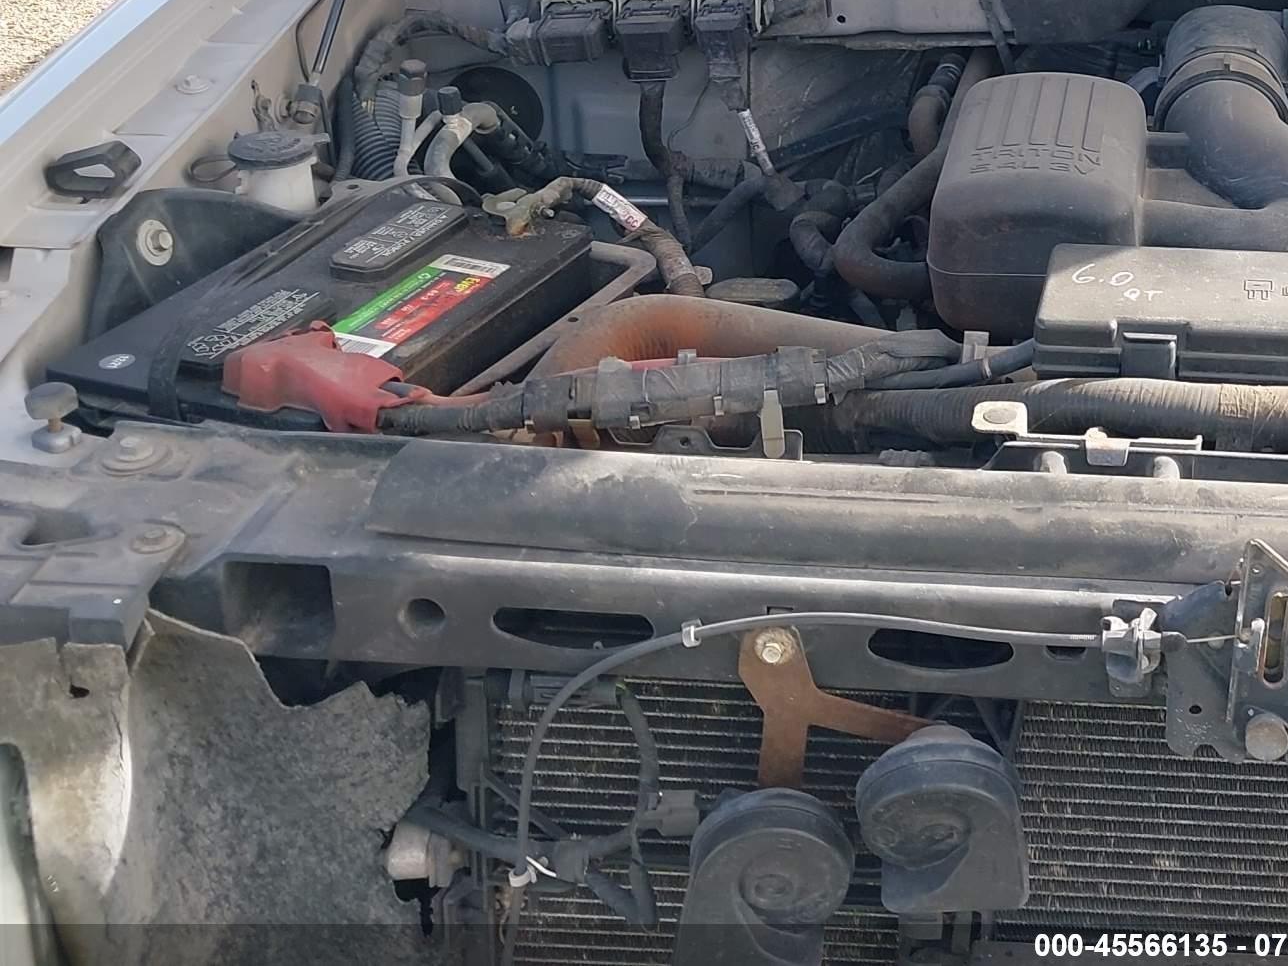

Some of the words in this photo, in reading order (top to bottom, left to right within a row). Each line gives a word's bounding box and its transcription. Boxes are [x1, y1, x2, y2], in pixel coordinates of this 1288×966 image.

[971, 148, 1101, 166] TRITON
[1049, 162, 1096, 175] 3V
[1072, 263, 1135, 286] 6.0
